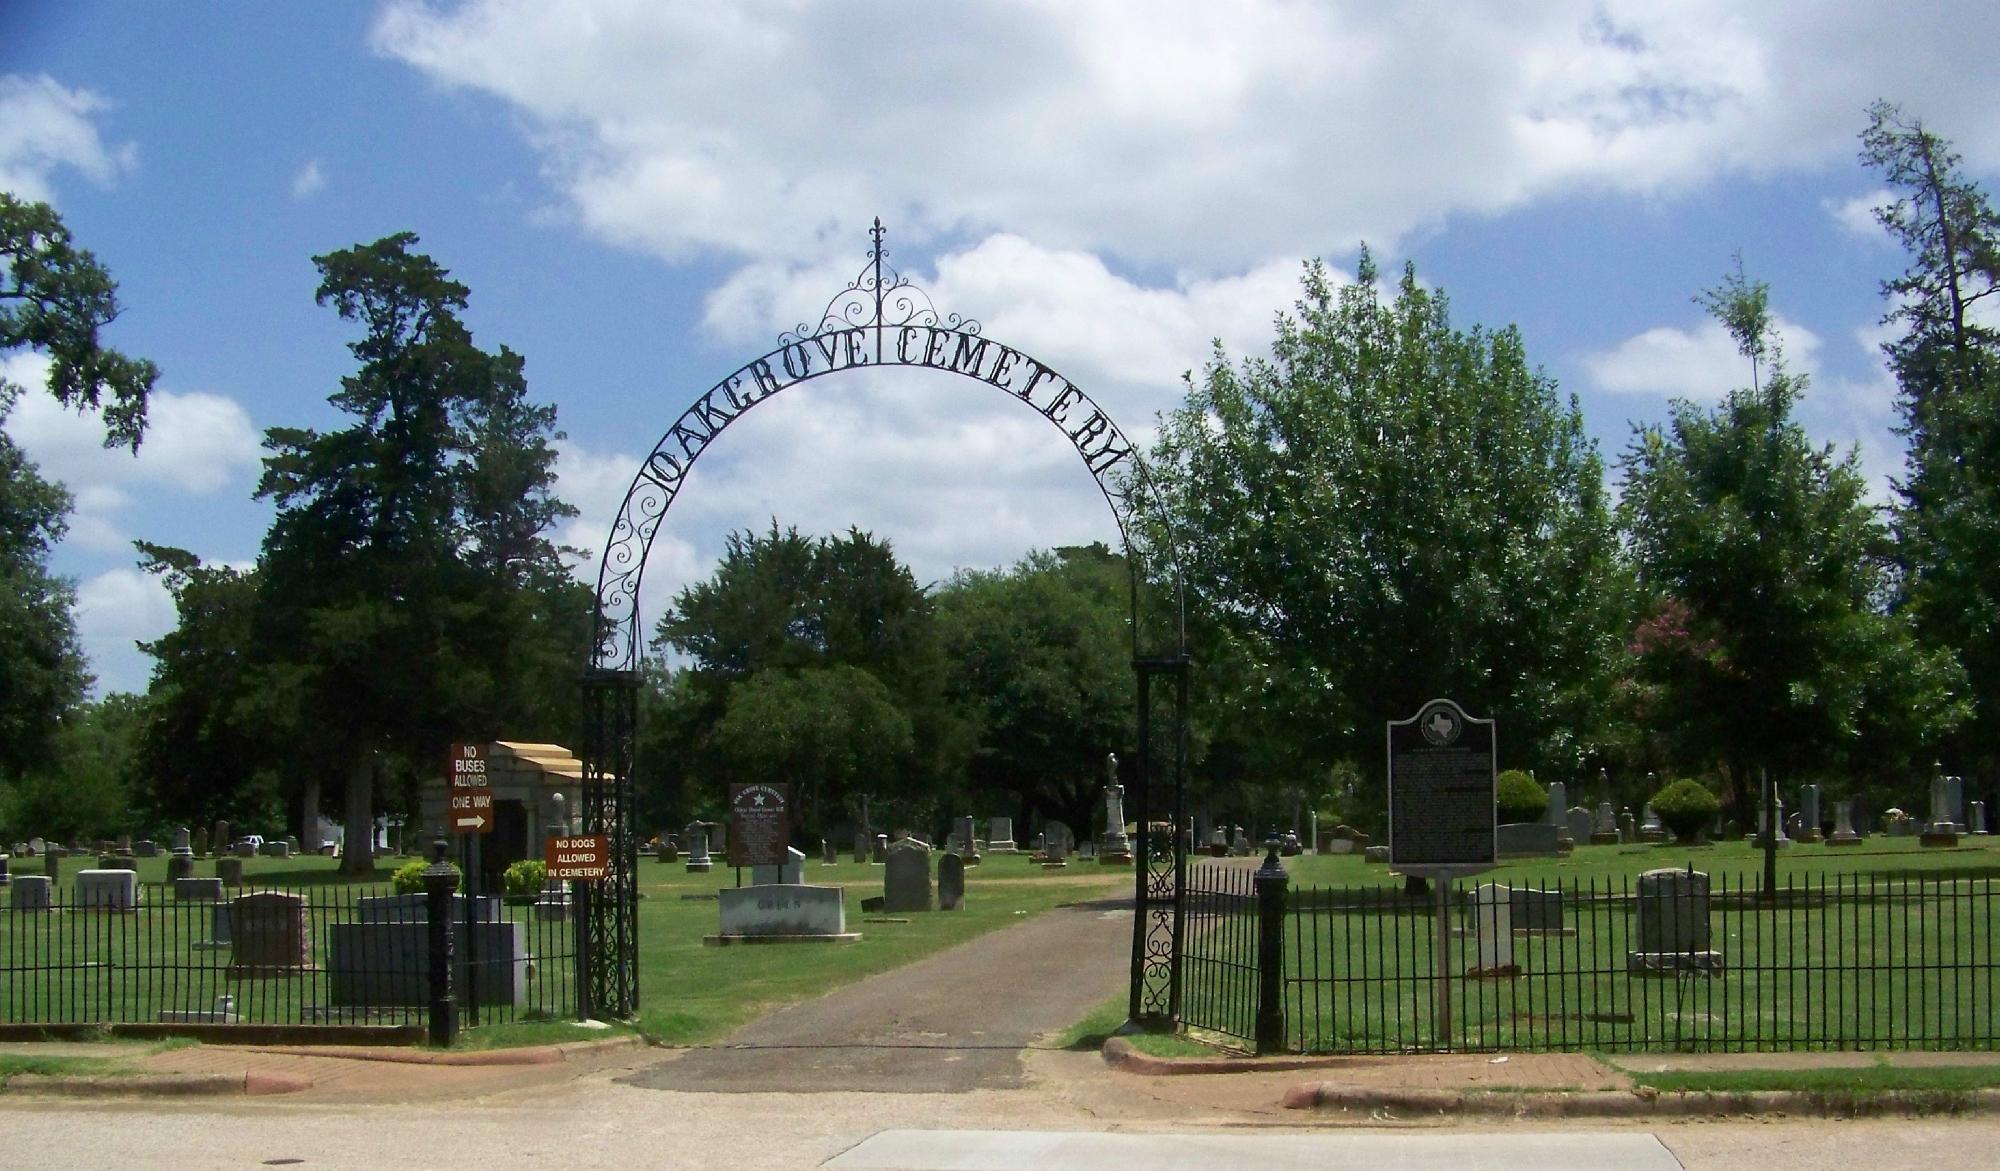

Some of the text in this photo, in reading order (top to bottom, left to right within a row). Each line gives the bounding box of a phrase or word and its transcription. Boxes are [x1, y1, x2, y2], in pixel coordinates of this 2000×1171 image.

[897, 327, 1131, 475] CEMETERY
[463, 746, 477, 758] NO
[456, 760, 485, 772] BUSES
[454, 774, 487, 787] ALLOWED
[452, 795, 491, 808] ONE WAY
[556, 839, 596, 848] NO DOGS
[557, 853, 596, 863] ALLOWED
[548, 867, 604, 877] IN CEMETERY
